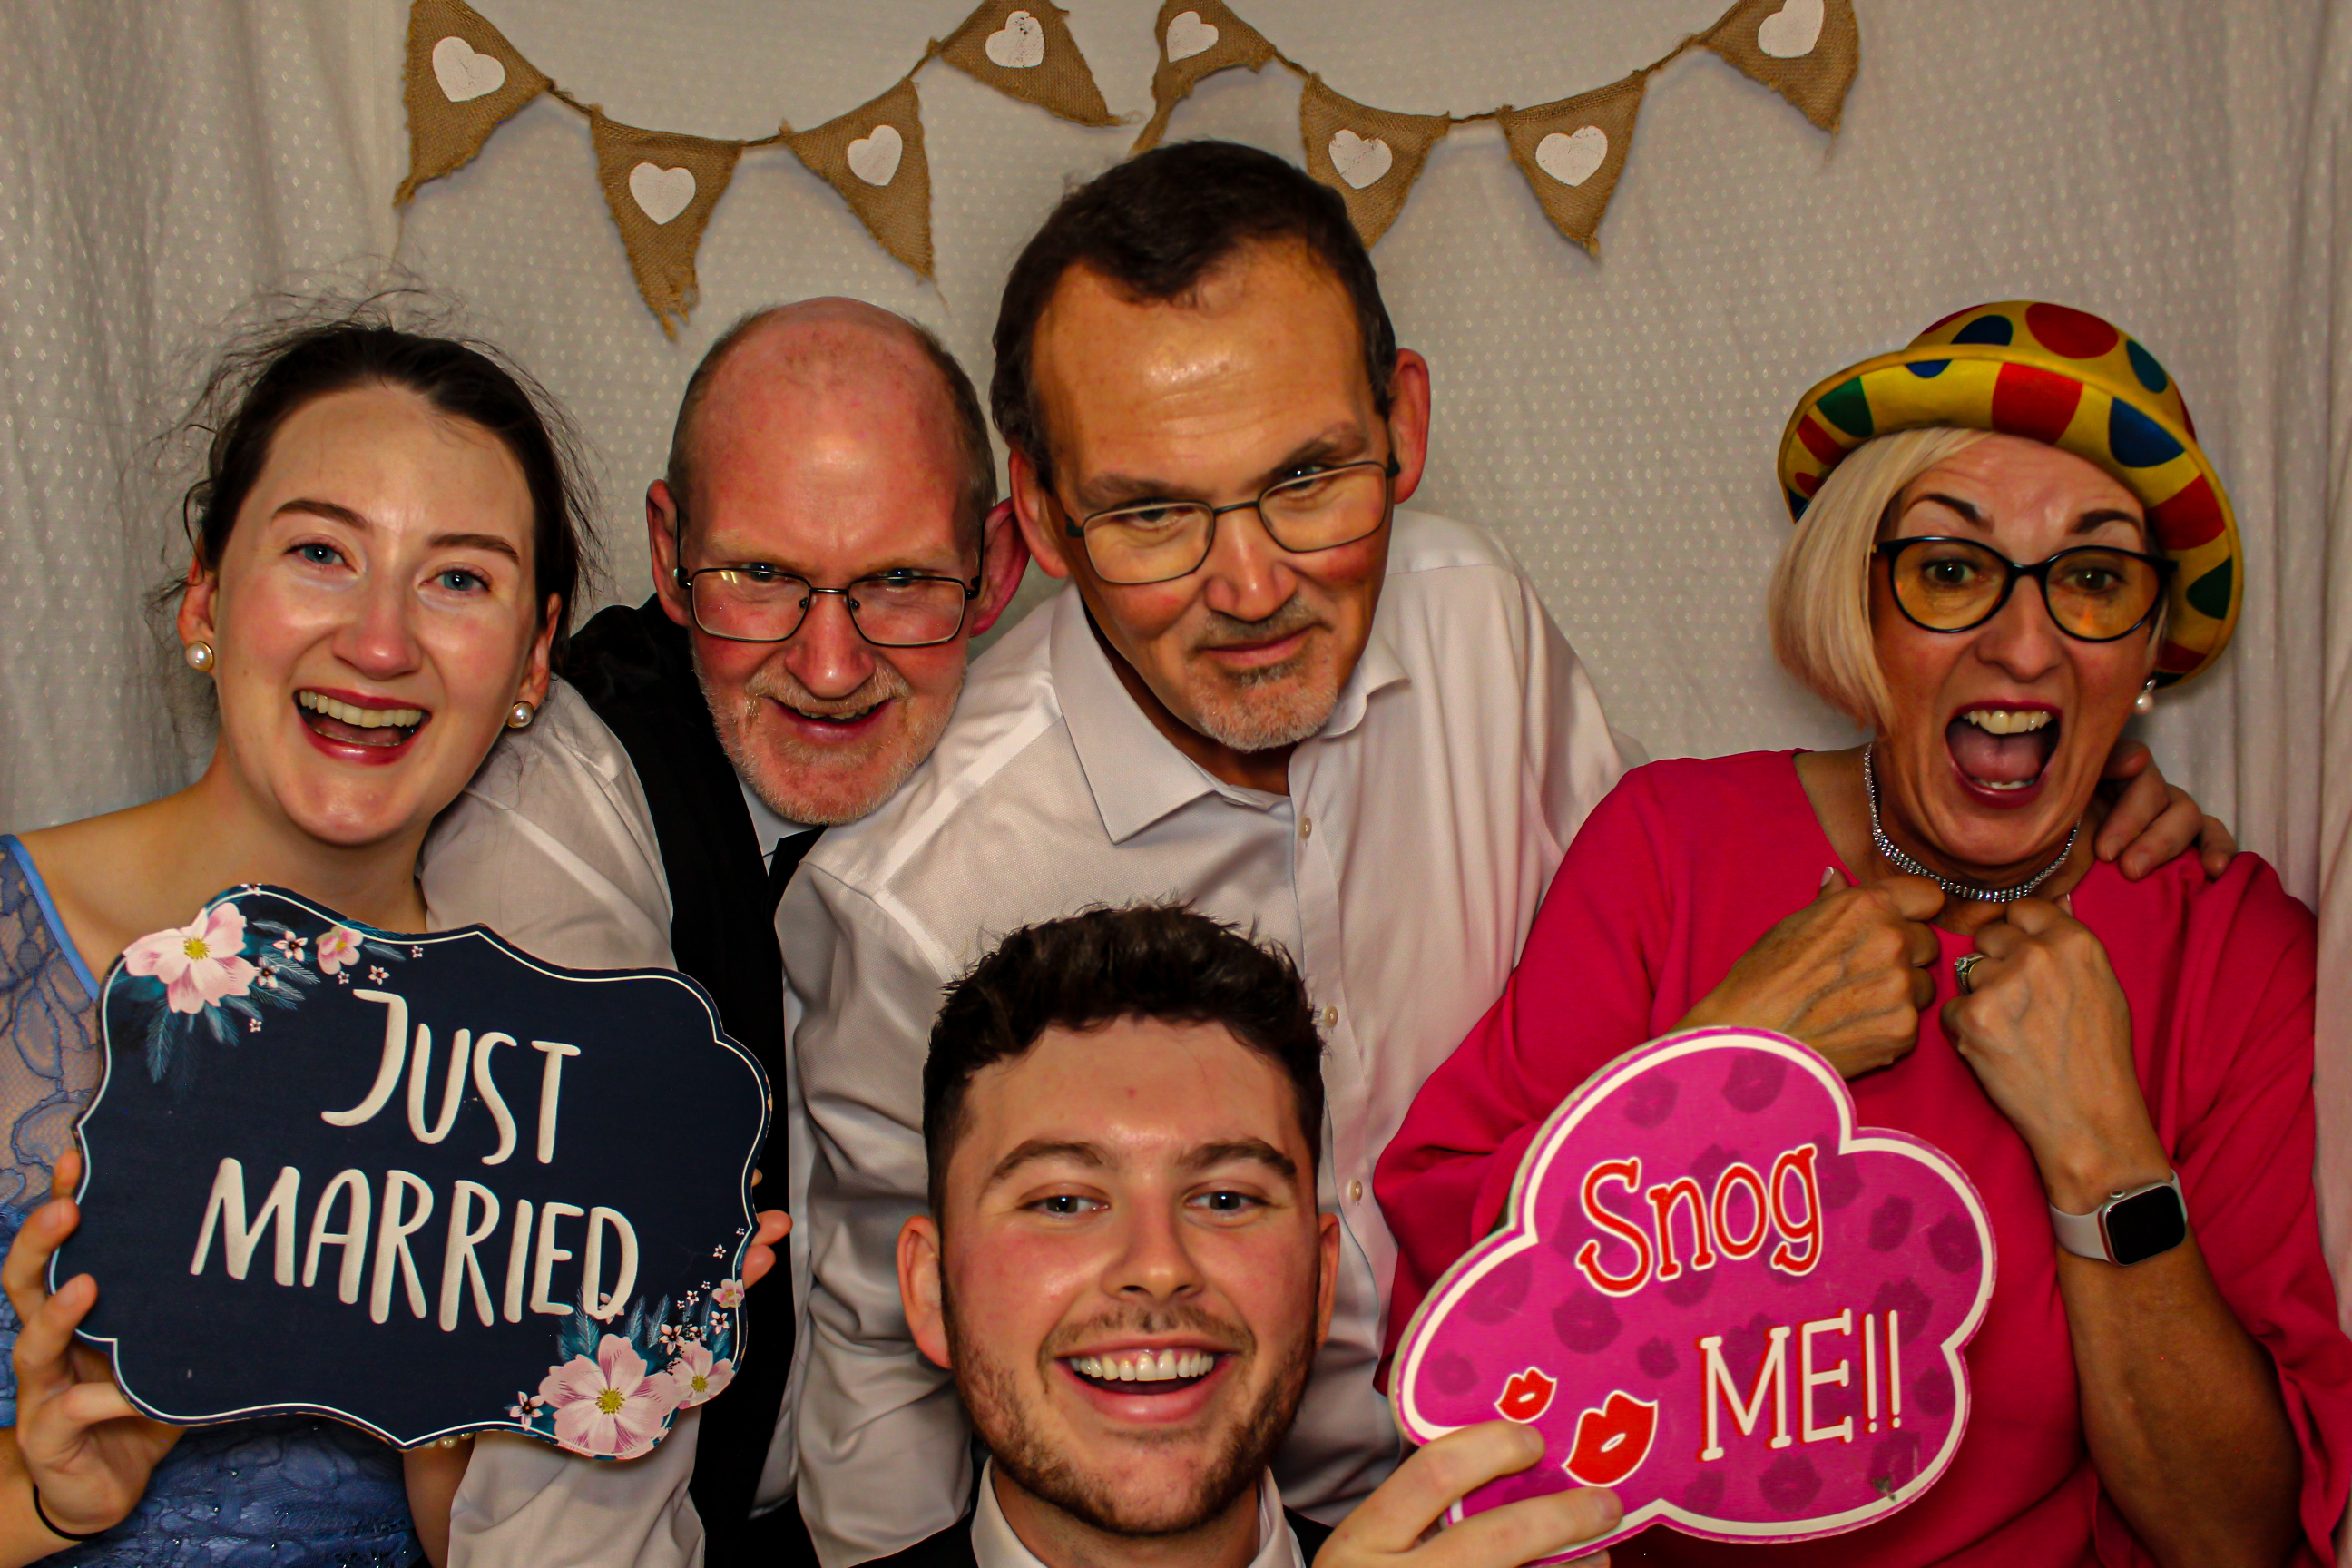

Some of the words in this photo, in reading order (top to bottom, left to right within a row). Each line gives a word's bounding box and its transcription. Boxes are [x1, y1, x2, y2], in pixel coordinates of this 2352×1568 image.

[321, 989, 580, 1164] JUST
[191, 1158, 638, 1332] MARRIED
[1576, 1143, 1822, 1296] Snog
[1697, 1308, 1901, 1461] ME!!
